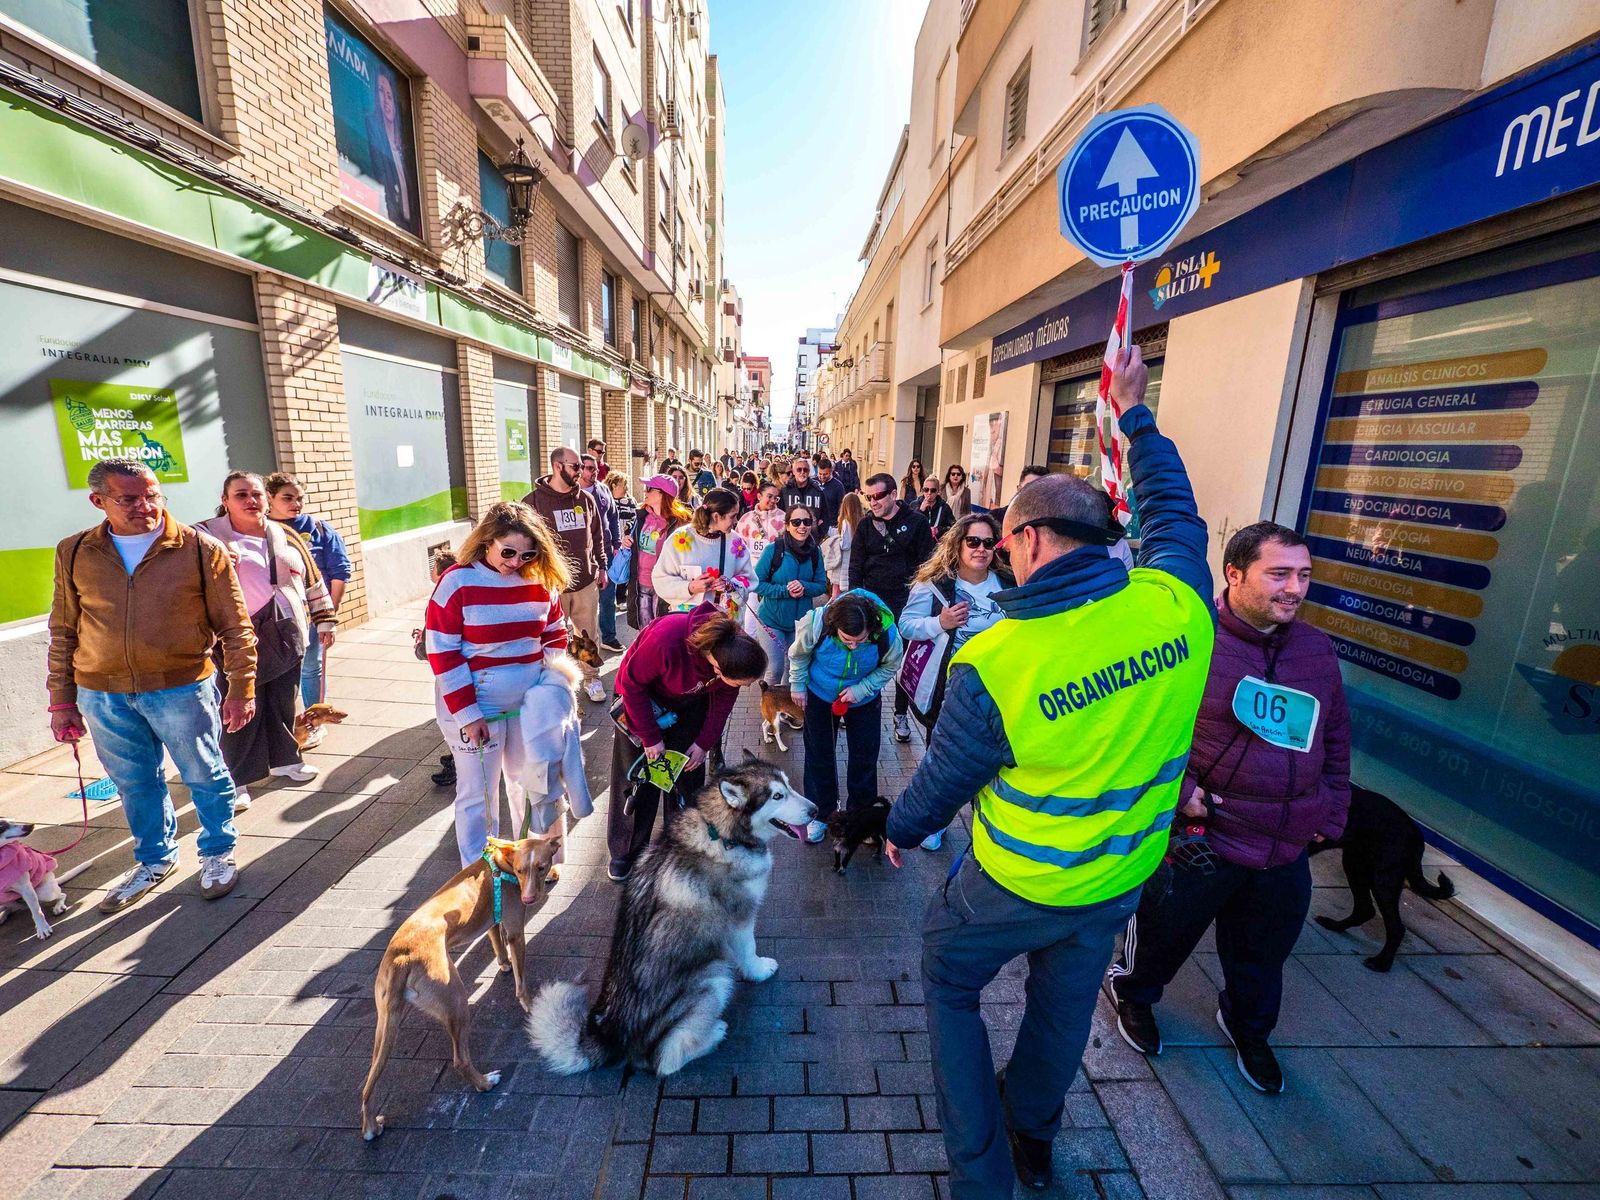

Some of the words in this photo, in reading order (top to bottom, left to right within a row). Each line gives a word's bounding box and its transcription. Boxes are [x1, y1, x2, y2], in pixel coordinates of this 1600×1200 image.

[1079, 187, 1181, 223] PRECAUCION
[1175, 251, 1206, 278] ISLA
[1157, 273, 1201, 302] SALUD
[1036, 316, 1070, 348] MÉDICAS
[42, 347, 120, 365] INTEGRALIA
[365, 405, 423, 419] INTEGRALIA
[1366, 397, 1413, 411] CIRUGIA
[1417, 392, 1477, 408] GENERAL
[92, 408, 134, 419] MENOS
[95, 419, 154, 431] BARRERAS
[1357, 424, 1402, 436] CIRUGIA
[1408, 422, 1477, 435] VASCULAR
[81, 442, 164, 461] INCLUSIÓN
[1365, 449, 1450, 463] CARDIOLOGIA
[1398, 477, 1465, 492] DIGESTIVO
[1344, 498, 1451, 520] ENDOCRINOLOGIA
[754, 541, 764, 551] 65
[1346, 548, 1423, 572] NEUMOLOGIA
[1343, 572, 1414, 597] NEUROLOGIA
[1339, 595, 1407, 622] PODOLOGIA
[1326, 615, 1410, 649] OFTALMOLOGIA
[1038, 634, 1190, 721] ORGANIZACION
[1254, 691, 1288, 724] 06
